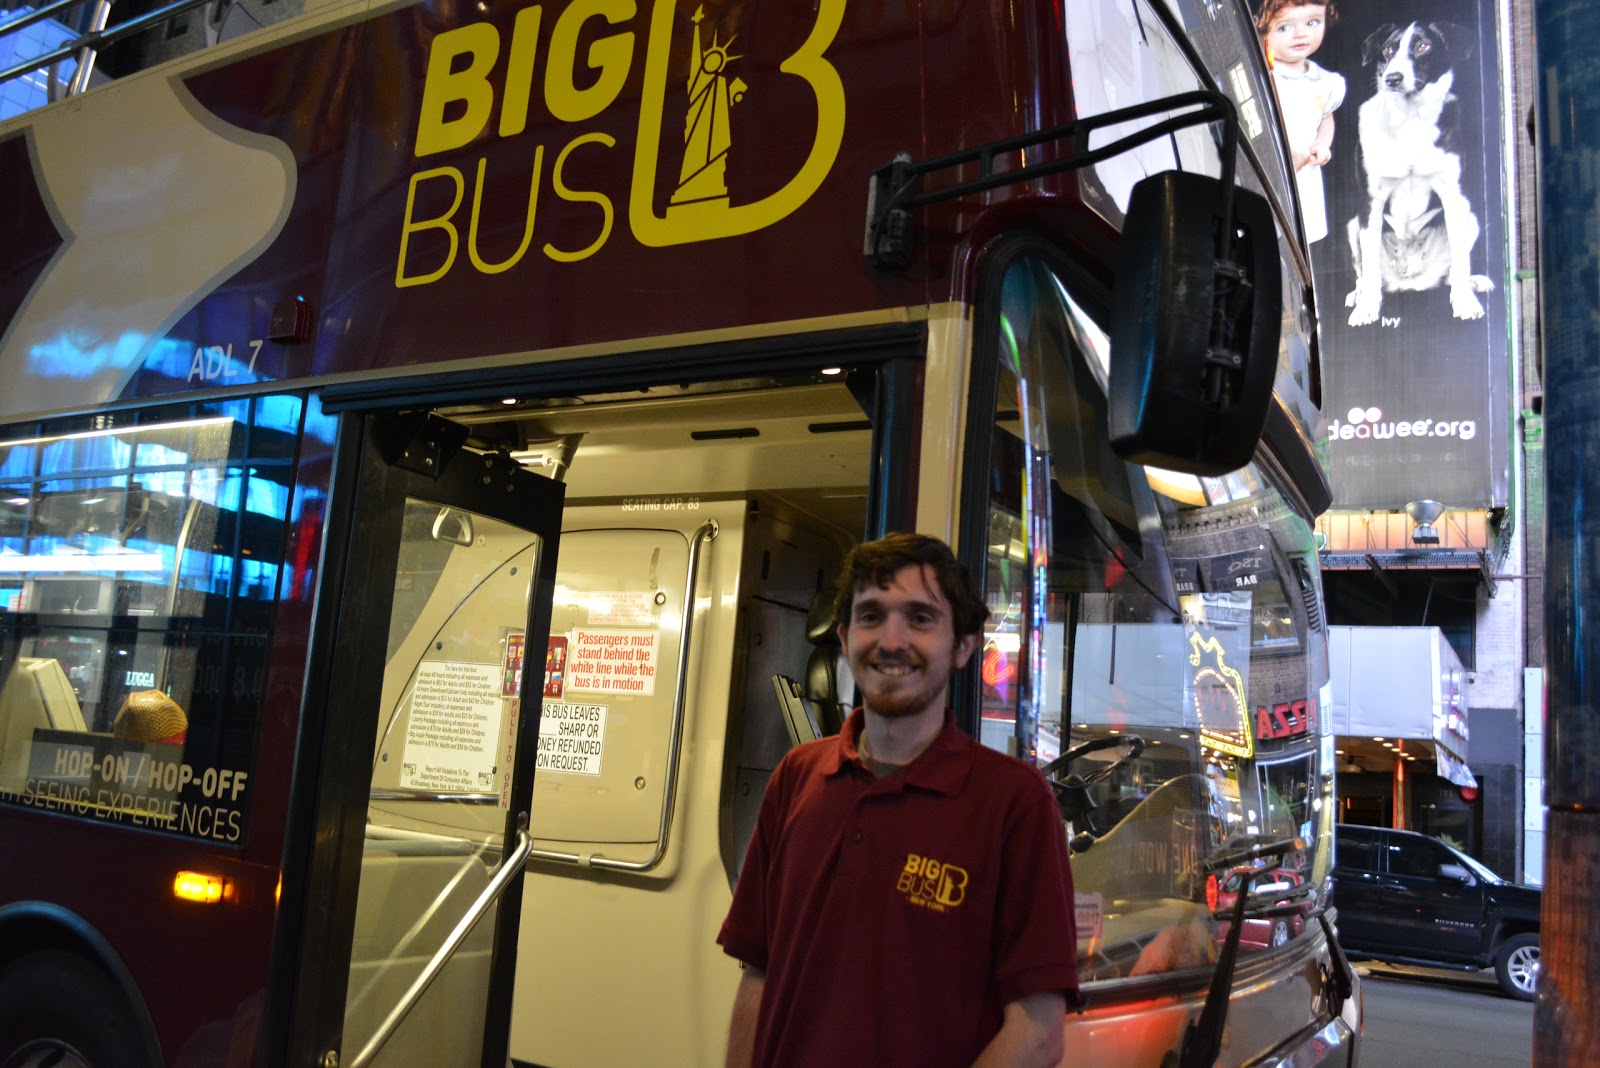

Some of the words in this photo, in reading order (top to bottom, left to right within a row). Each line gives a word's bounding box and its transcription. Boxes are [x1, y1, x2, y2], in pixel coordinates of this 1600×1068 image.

[414, 0, 637, 157] BIG
[395, 132, 616, 288] BUS
[1382, 316, 1400, 328] Ivy
[187, 344, 238, 383] ADL
[247, 340, 264, 374] 7
[621, 498, 660, 511] SEATING
[663, 498, 684, 510] CAP.
[578, 632, 628, 648] Passengers
[631, 634, 654, 646] must
[578, 647, 602, 659] stand
[604, 648, 634, 660] behind
[636, 649, 650, 661] the
[571, 661, 594, 674] white
[596, 662, 612, 674] line
[614, 663, 637, 676] while
[640, 664, 654, 676] the
[125, 671, 154, 687] LUGGA
[575, 675, 590, 688] bus
[592, 676, 600, 688] is
[602, 676, 610, 688] in
[612, 678, 644, 690] motion
[552, 705, 568, 719] BUS
[569, 706, 600, 721] LEAVES
[559, 722, 585, 737] SHARP
[587, 724, 599, 738] OR
[506, 746, 512, 763] TO
[558, 738, 601, 755] REFUNDED
[550, 754, 588, 771] REQUEST.
[54, 748, 130, 784] HOP-ON
[150, 760, 248, 801] HOP-OFF
[502, 773, 510, 809] OPEN
[95, 790, 242, 842] EXPERIENCES
[904, 853, 940, 880] BIG
[897, 871, 936, 900] BUS
